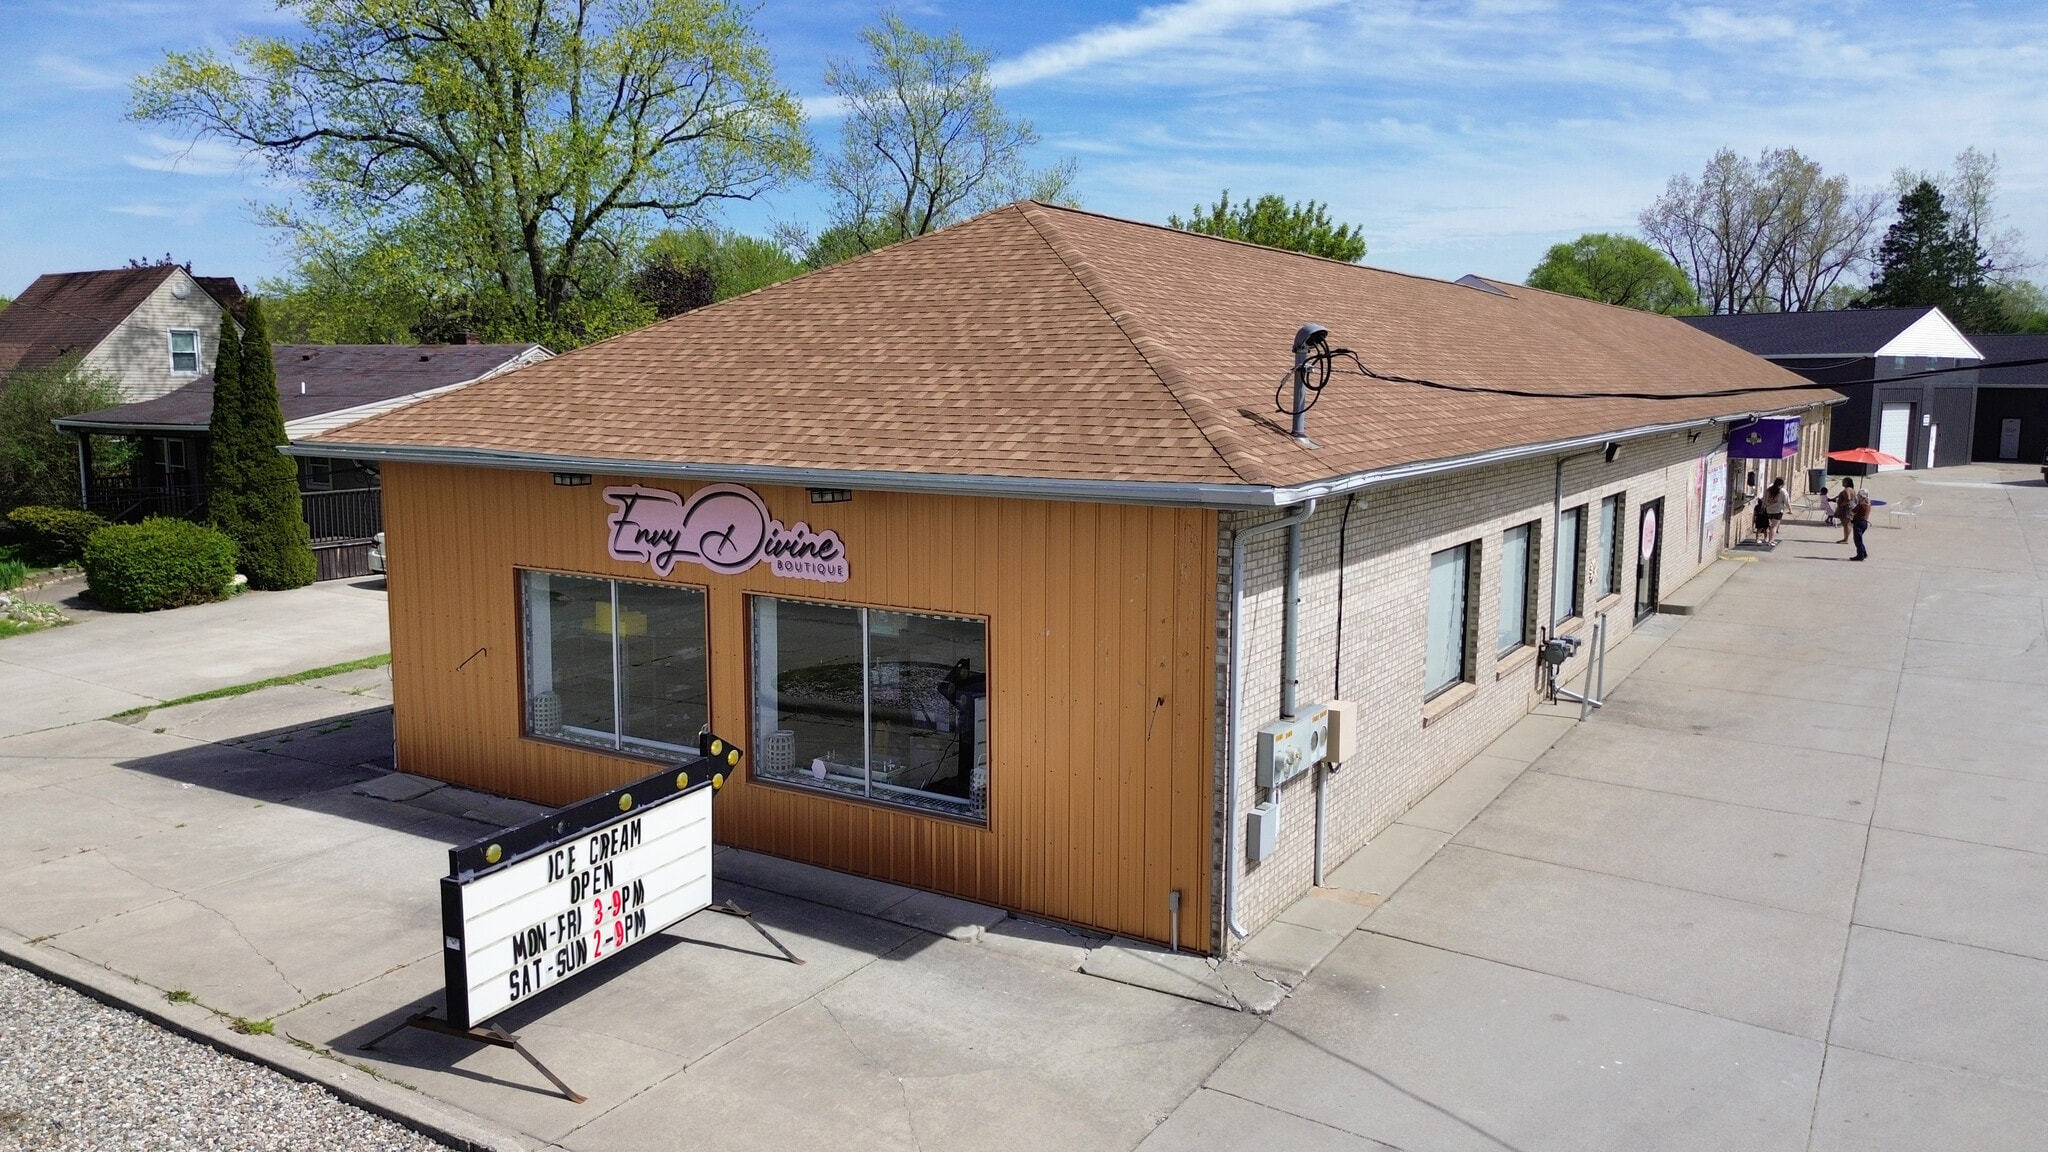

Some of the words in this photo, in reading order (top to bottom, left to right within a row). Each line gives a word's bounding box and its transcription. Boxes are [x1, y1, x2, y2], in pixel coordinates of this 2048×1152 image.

[608, 492, 700, 570] Envy
[683, 491, 839, 568] Divine
[777, 560, 844, 576] BOUTIQUE
[548, 845, 576, 883] ICE
[589, 818, 642, 865] CREAM
[570, 860, 614, 905] OPEN
[509, 937, 588, 1001] SAT-SUN
[593, 908, 646, 958] 2-9PM
[512, 906, 582, 965] MON-FRI
[593, 878, 645, 926] 3-9PM
